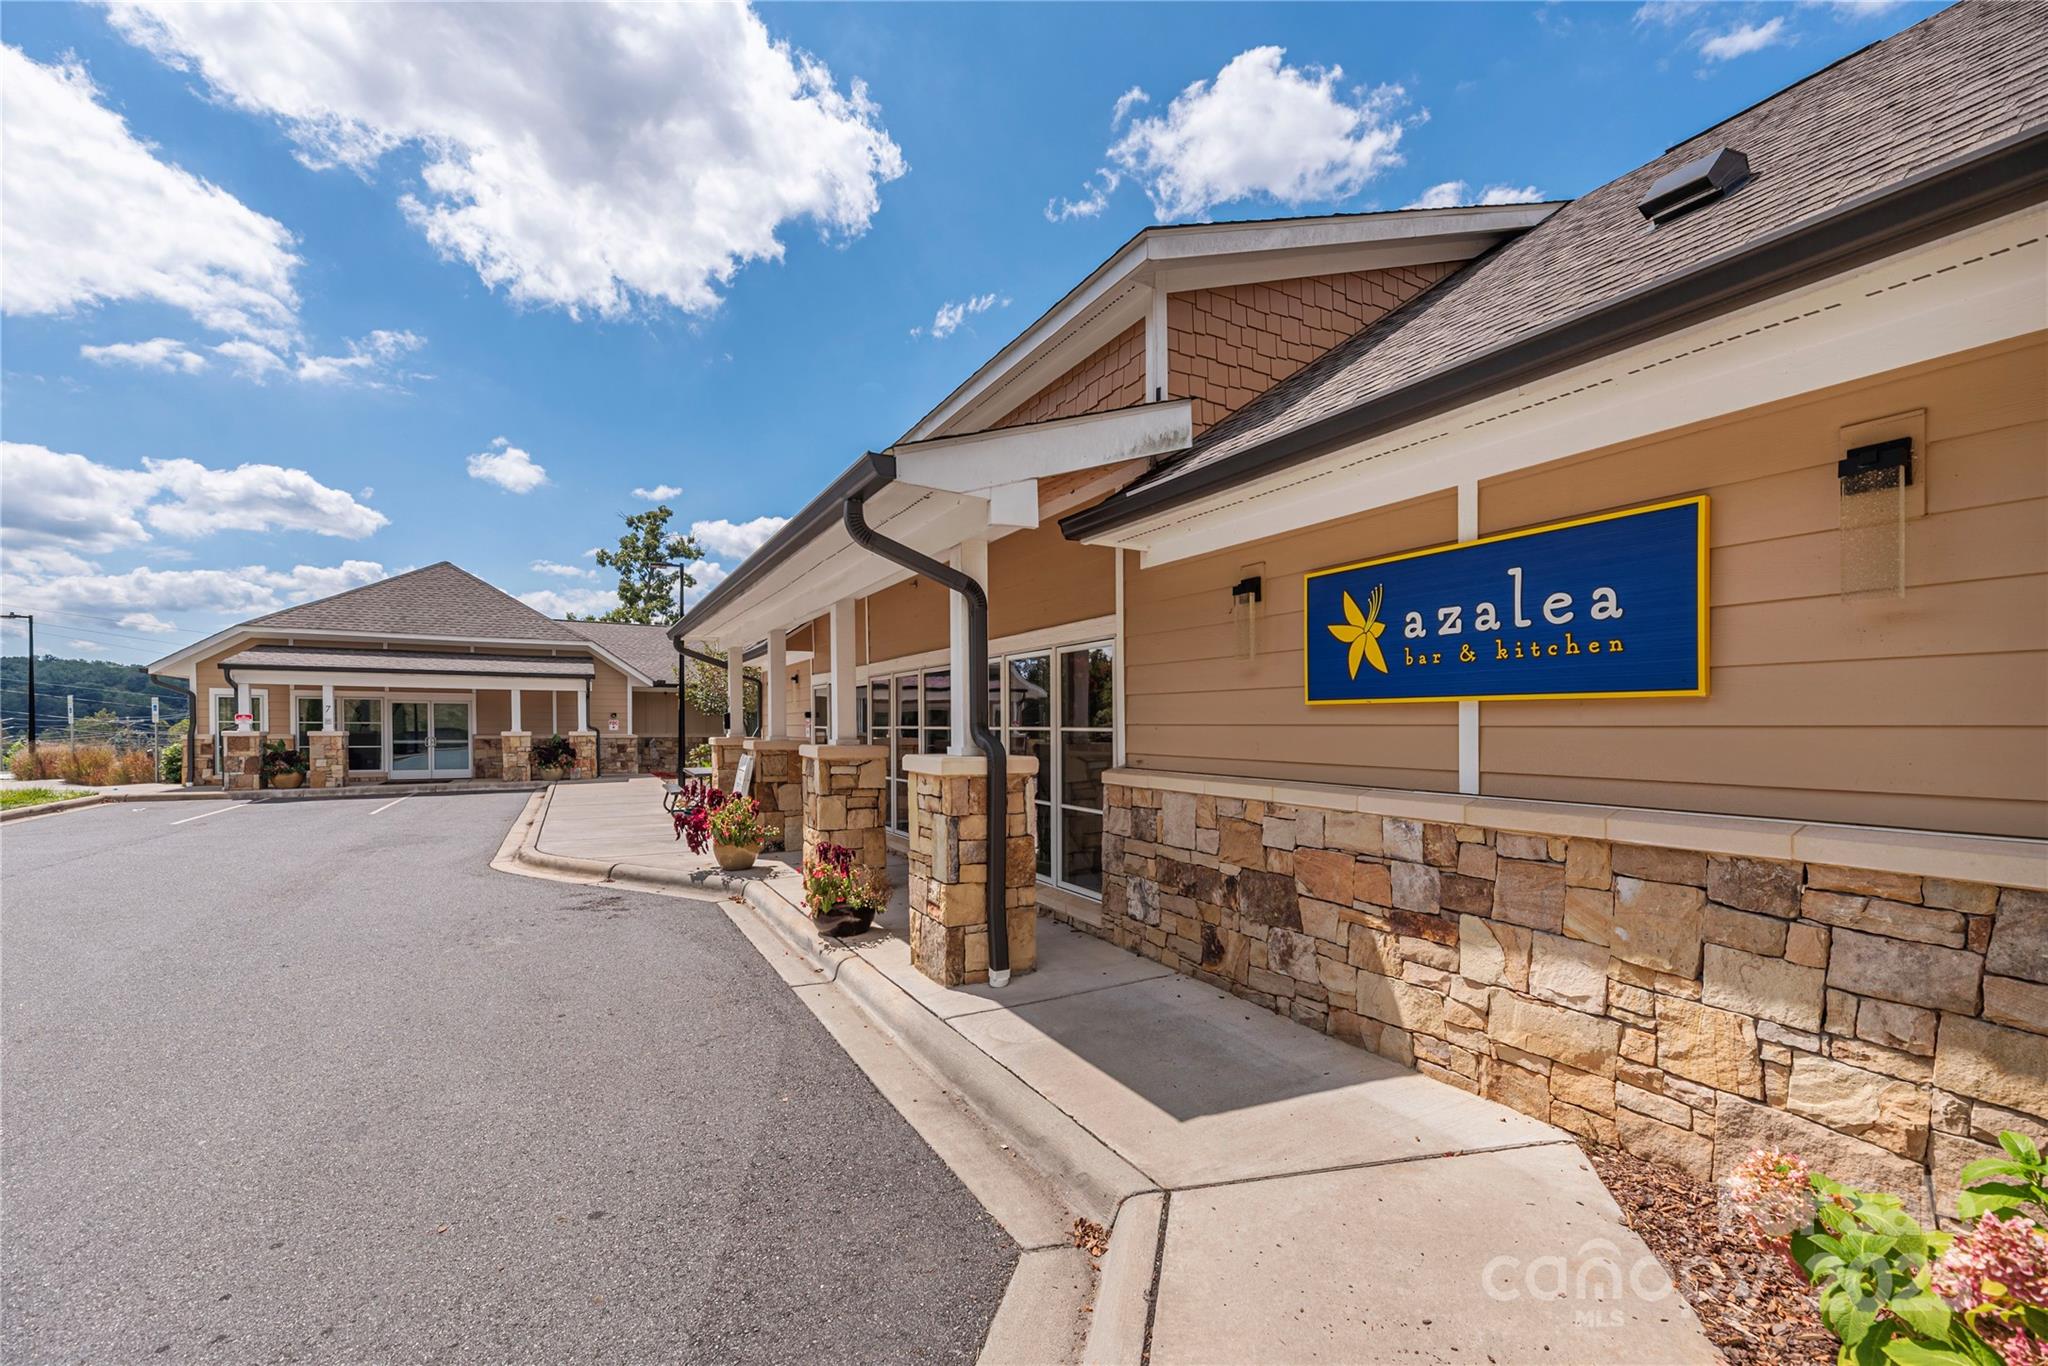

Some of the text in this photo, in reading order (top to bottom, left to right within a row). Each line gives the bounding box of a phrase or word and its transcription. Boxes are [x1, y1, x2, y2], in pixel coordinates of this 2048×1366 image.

[1403, 566, 1624, 640] azalea
[1404, 632, 1624, 667] bar & kitchen
